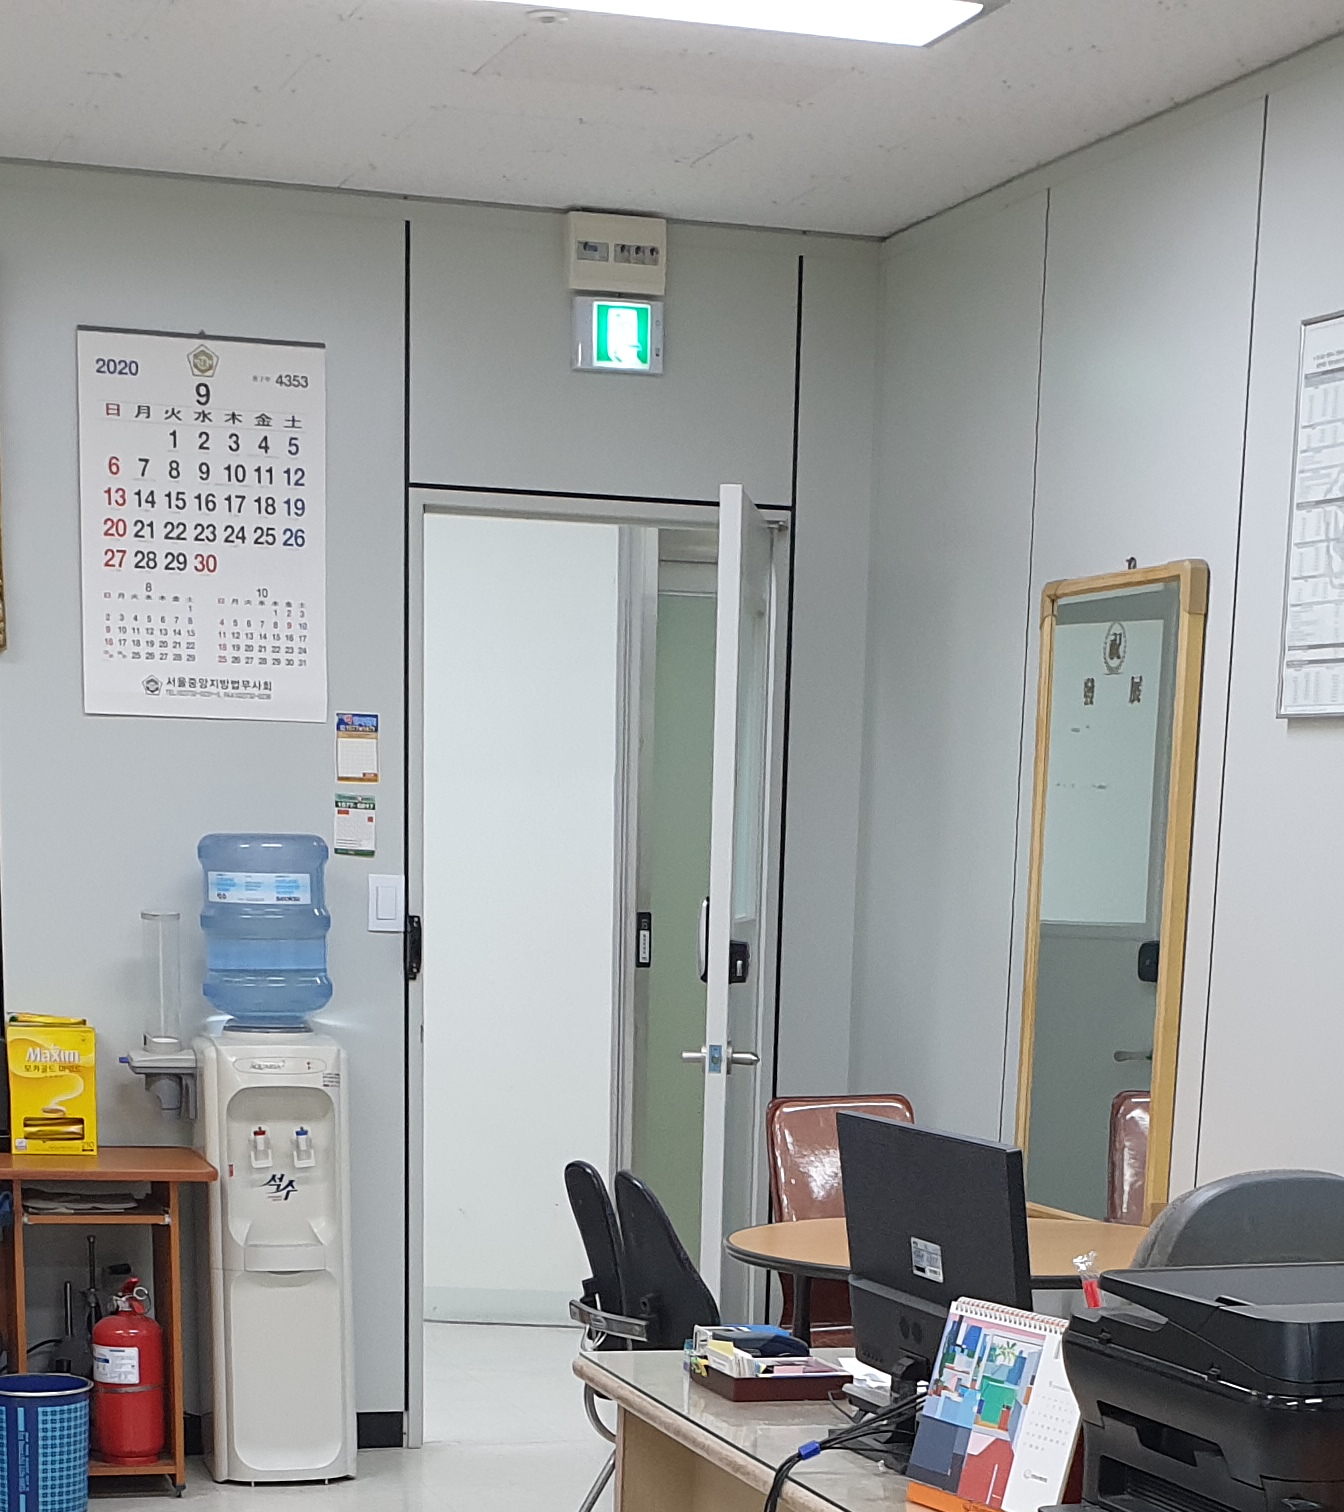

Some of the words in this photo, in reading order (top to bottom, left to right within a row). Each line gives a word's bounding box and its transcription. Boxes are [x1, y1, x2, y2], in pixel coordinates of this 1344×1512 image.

[96, 358, 139, 376] 2020
[275, 374, 309, 388] 4353
[195, 383, 210, 406] 9
[106, 403, 120, 417] 日
[135, 405, 150, 419] 月
[165, 408, 182, 421] 火
[194, 410, 212, 423] 水
[225, 412, 242, 425] 木
[255, 413, 272, 427] 金
[284, 415, 302, 429] 土
[169, 430, 176, 448] 1
[199, 431, 210, 450] 2
[229, 433, 240, 452] 3
[258, 436, 269, 454] 4
[288, 437, 299, 455] 5
[109, 456, 119, 475] 6
[138, 458, 149, 477] 7
[169, 460, 180, 479] 8
[199, 462, 210, 480] 9
[224, 464, 246, 483] 10
[254, 466, 273, 484] 11
[283, 468, 305, 486] 12
[104, 487, 126, 506] 13
[134, 489, 156, 508] 14
[165, 491, 186, 510] 15
[194, 493, 216, 512] 16
[224, 495, 246, 513] 17
[254, 496, 276, 515] 18
[284, 498, 305, 517] 19
[104, 518, 127, 537] 20
[134, 520, 154, 538] 21
[164, 521, 187, 540] 22
[194, 523, 217, 542] 23
[224, 525, 246, 544] 24
[254, 527, 276, 545] 25
[283, 528, 305, 547] 26
[104, 549, 126, 568] 27
[134, 550, 157, 569] 28
[164, 552, 187, 571] 29
[194, 554, 217, 573] 30
[145, 582, 152, 592] 8
[257, 588, 268, 598] 10
[26, 1046, 81, 1063] Maxim
[260, 1174, 298, 1201] 석수
